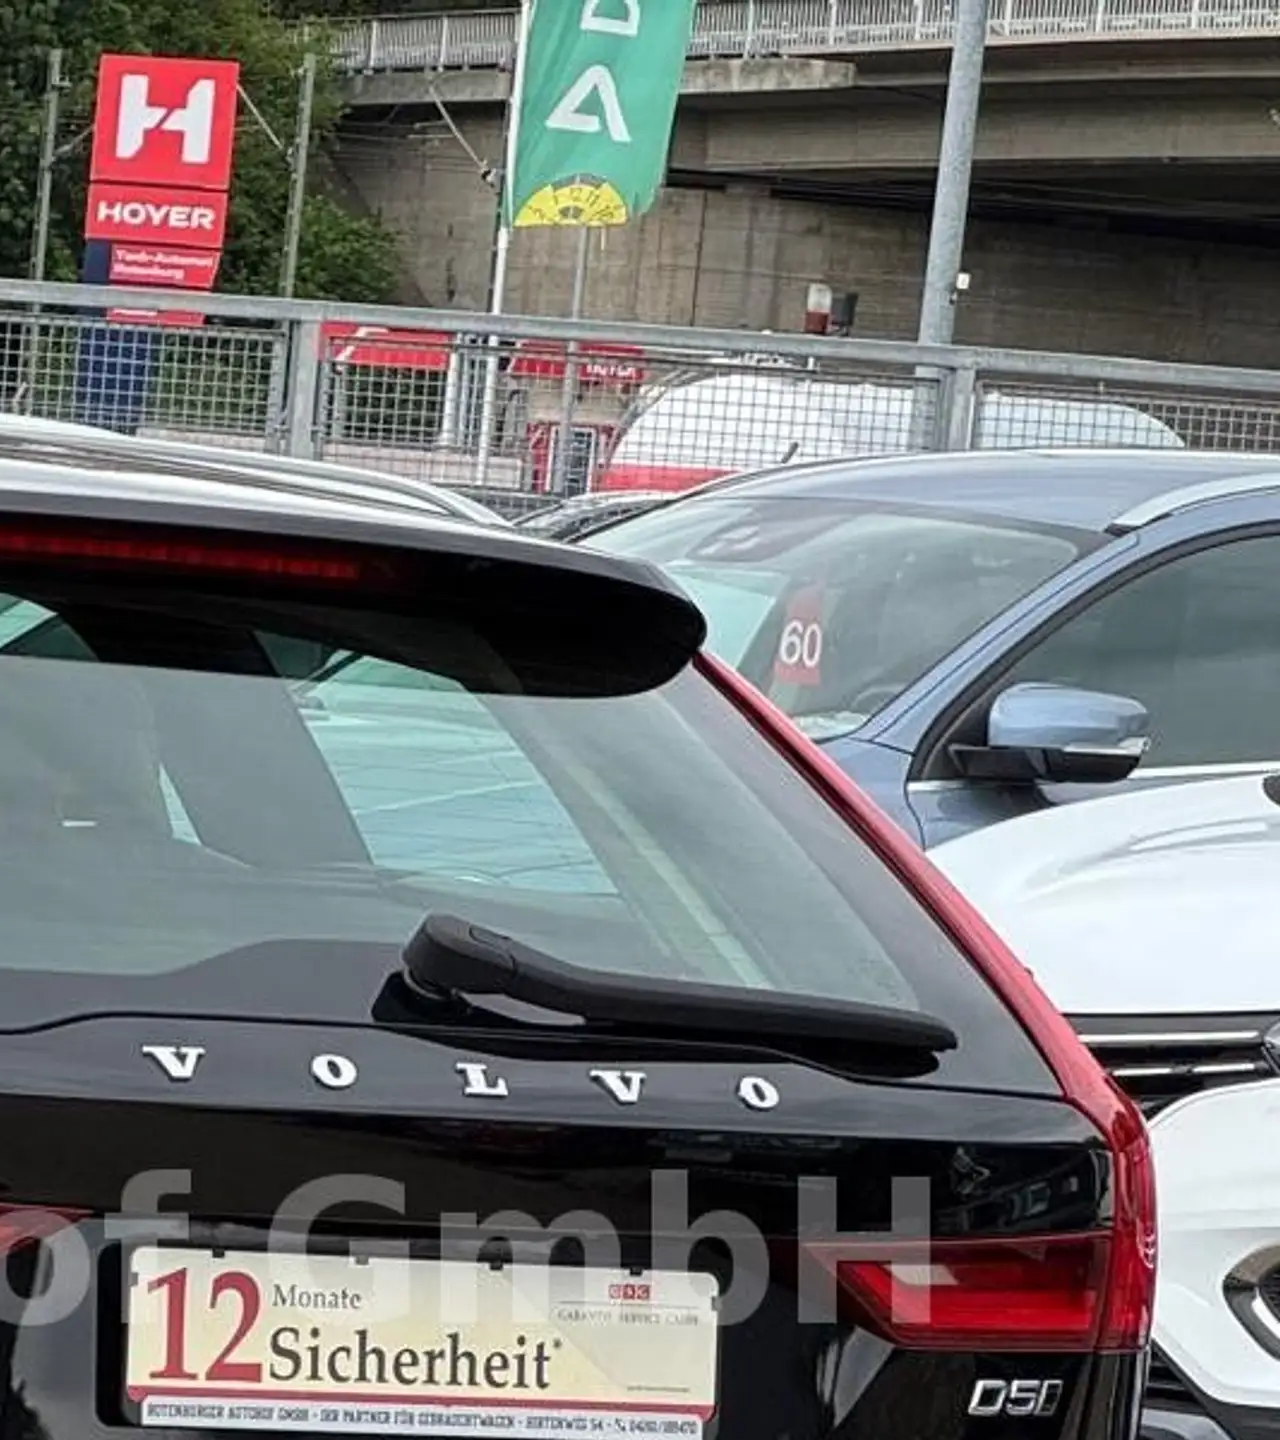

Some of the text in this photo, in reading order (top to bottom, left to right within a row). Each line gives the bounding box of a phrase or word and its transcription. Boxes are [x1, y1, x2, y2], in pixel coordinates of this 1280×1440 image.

[97, 201, 216, 230] HOYER
[778, 619, 822, 668] 60
[142, 1045, 781, 1110] VOLVO
[146, 1267, 362, 1384] 12 Monate
